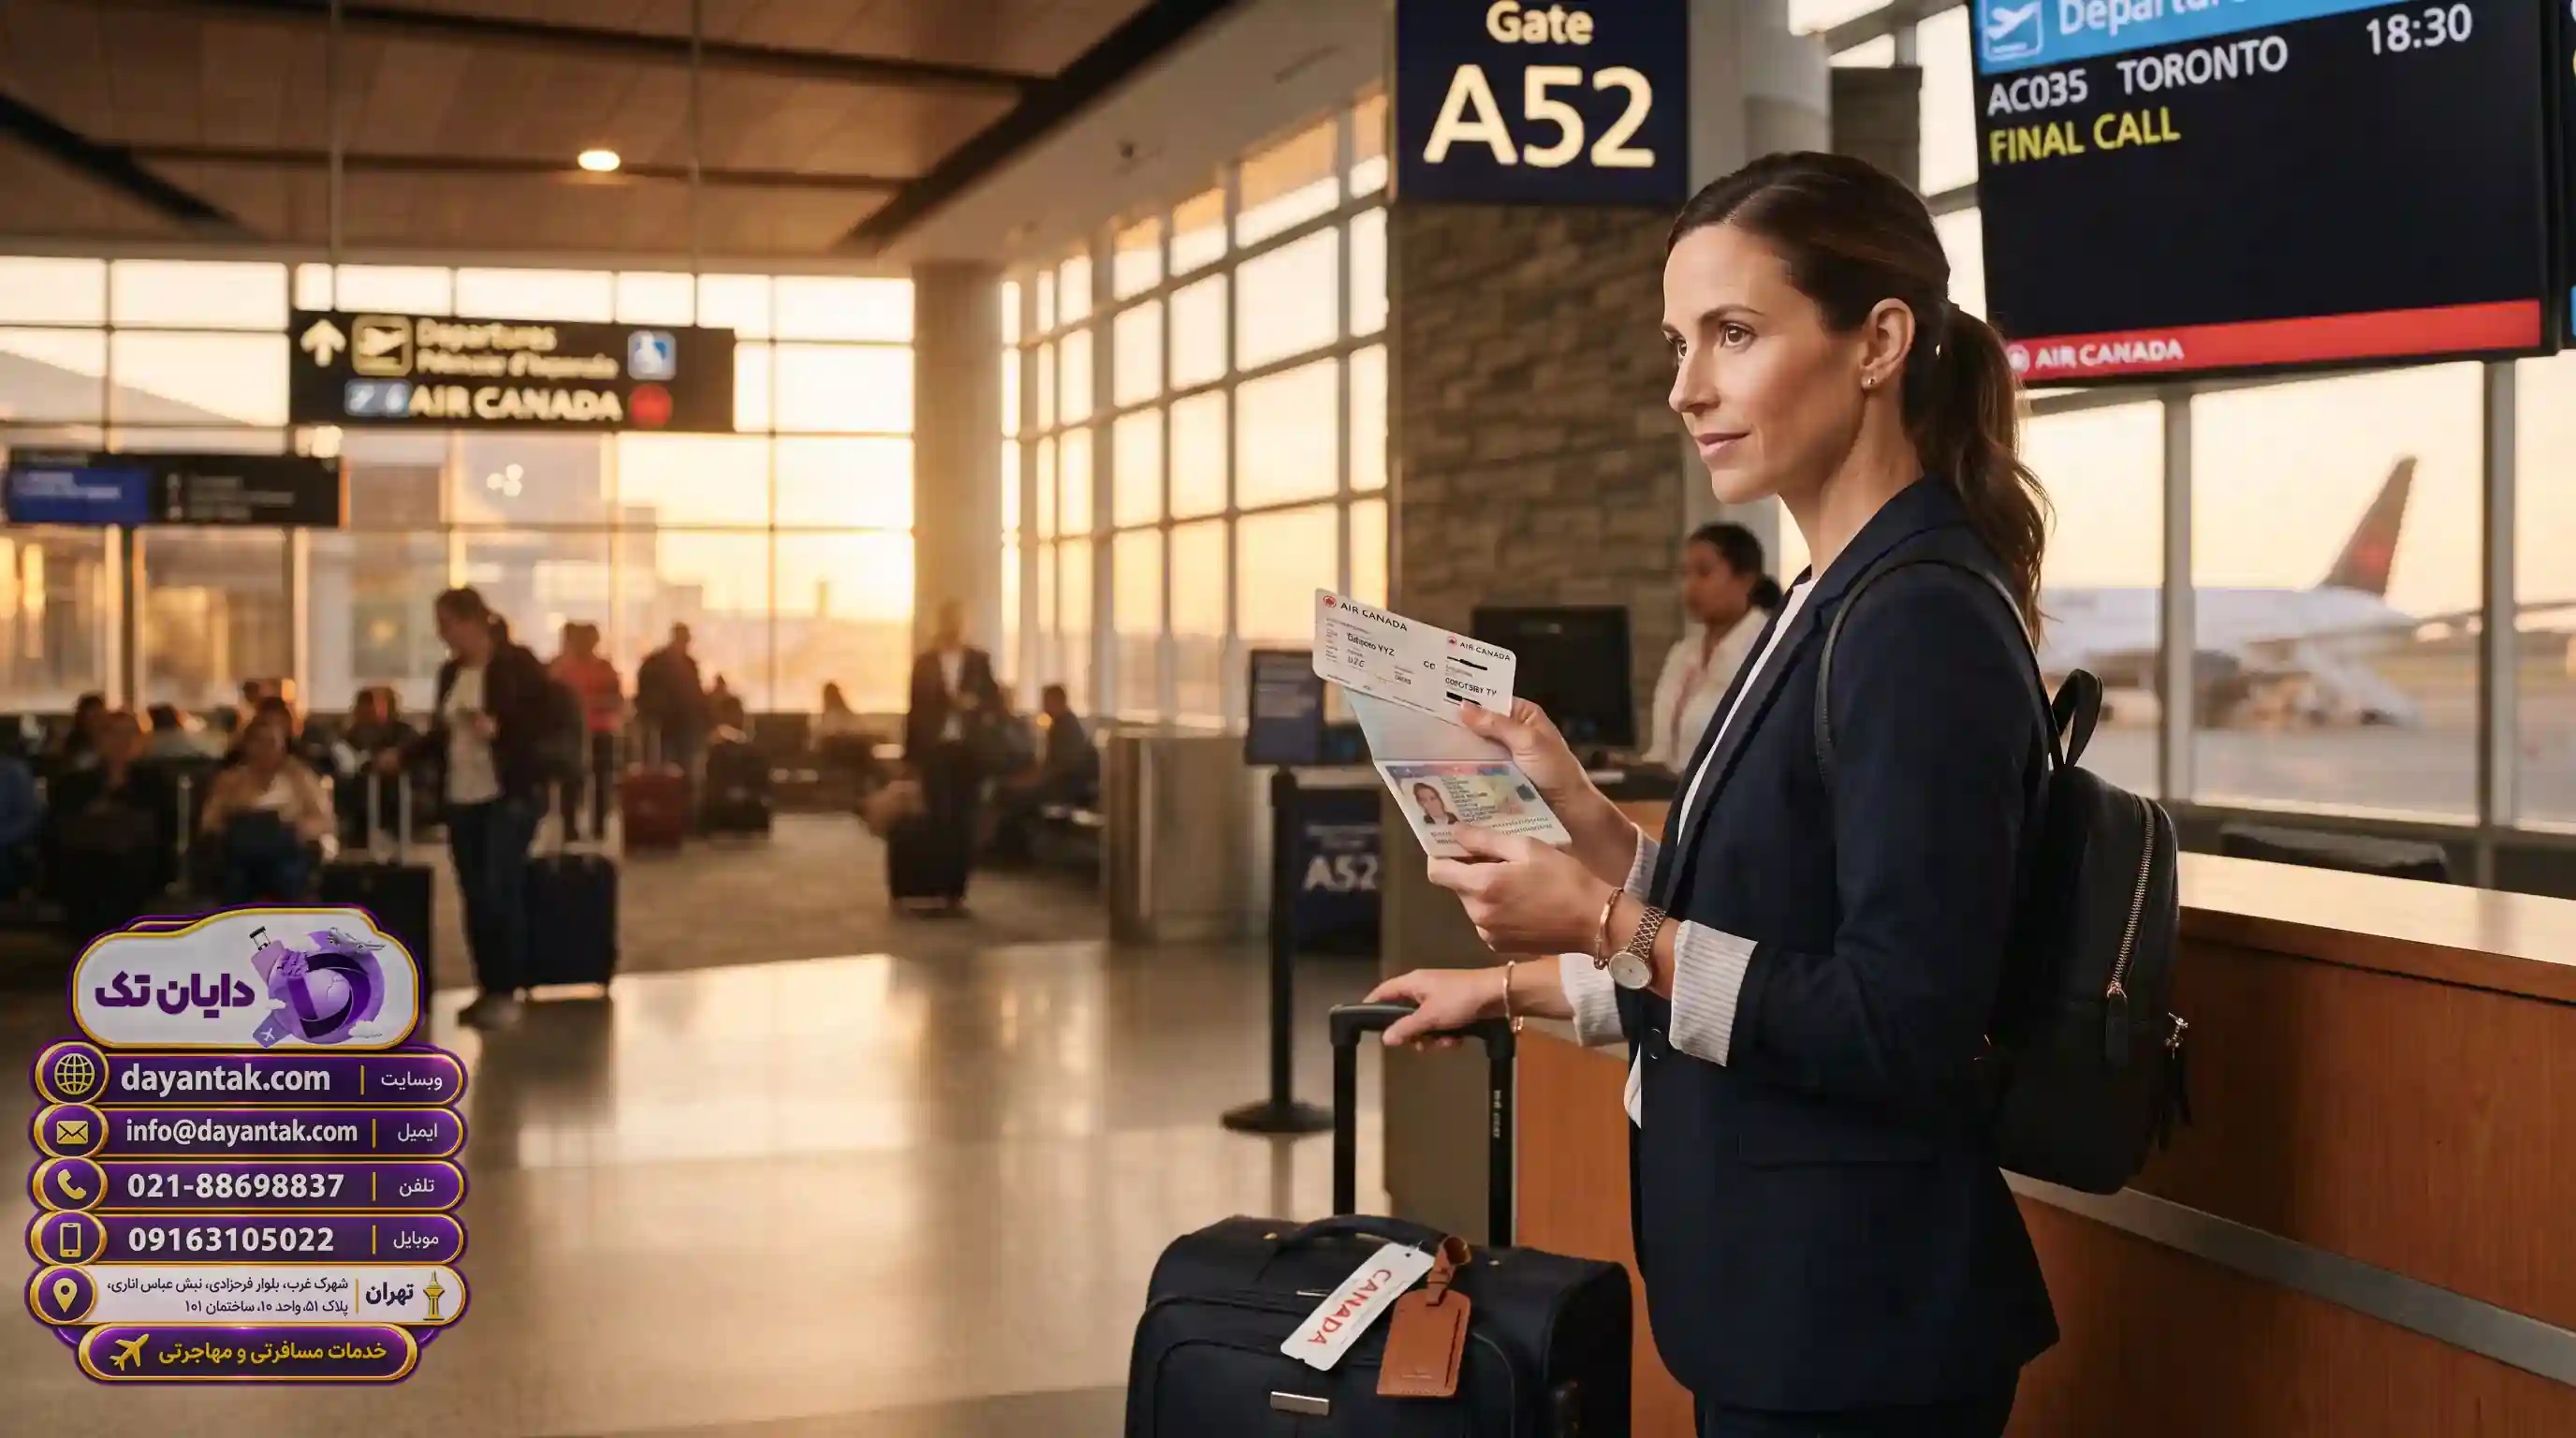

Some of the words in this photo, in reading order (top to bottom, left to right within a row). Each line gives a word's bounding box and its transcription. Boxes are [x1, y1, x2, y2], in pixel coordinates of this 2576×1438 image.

[1486, 0, 1594, 45] Gate
[1987, 68, 2088, 116] AC035
[2116, 36, 2289, 95] TORONTO
[2366, 3, 2472, 55] 18:30
[1423, 64, 1656, 168] A52
[1989, 121, 2085, 165] FINAL
[2093, 106, 2181, 150] CALL
[2035, 345, 2076, 370] AIR
[2079, 338, 2185, 366] CANADA
[409, 384, 470, 418] AIR
[474, 386, 622, 421] CANADA
[1340, 602, 1359, 614] AIR
[1362, 609, 1408, 632] CANADA
[1459, 641, 1474, 652] AIR
[1475, 647, 1511, 661] CANADA
[1303, 854, 1379, 891] A52
[1308, 1269, 1393, 1345] CANADA
